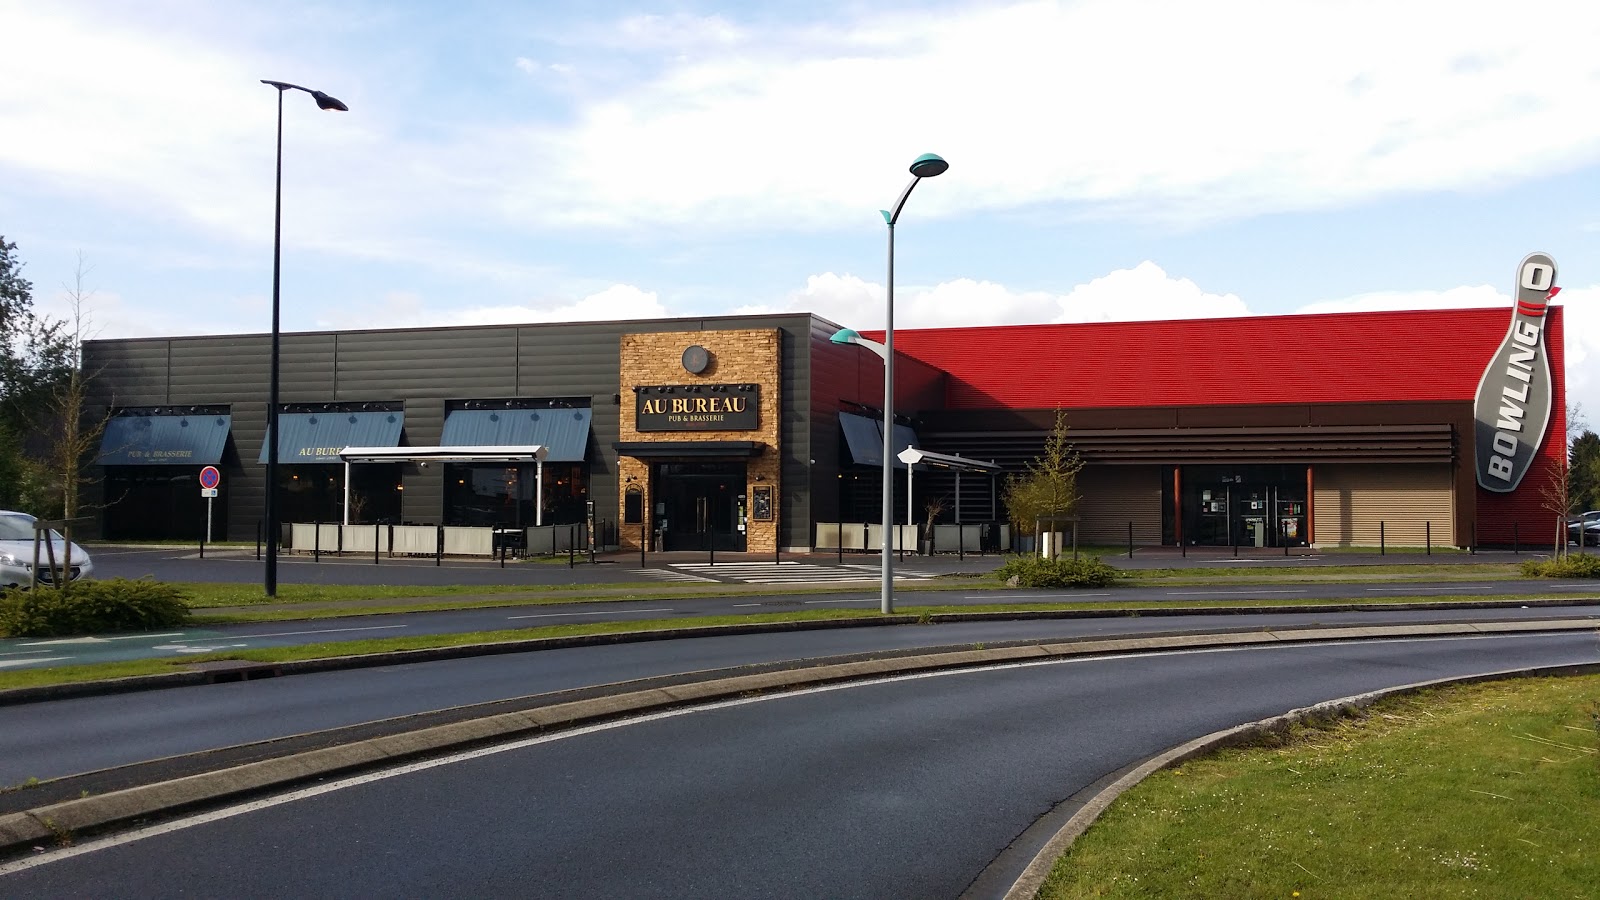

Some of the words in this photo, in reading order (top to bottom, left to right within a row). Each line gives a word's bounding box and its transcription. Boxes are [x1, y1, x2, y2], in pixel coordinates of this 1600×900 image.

[642, 398, 668, 414] AU
[671, 397, 746, 414] BUREAU
[1487, 319, 1540, 483] BOWLING
[128, 450, 142, 458] PUB
[153, 450, 192, 458] BRASSERIE
[299, 447, 314, 456] AU
[315, 447, 343, 456] BURE
